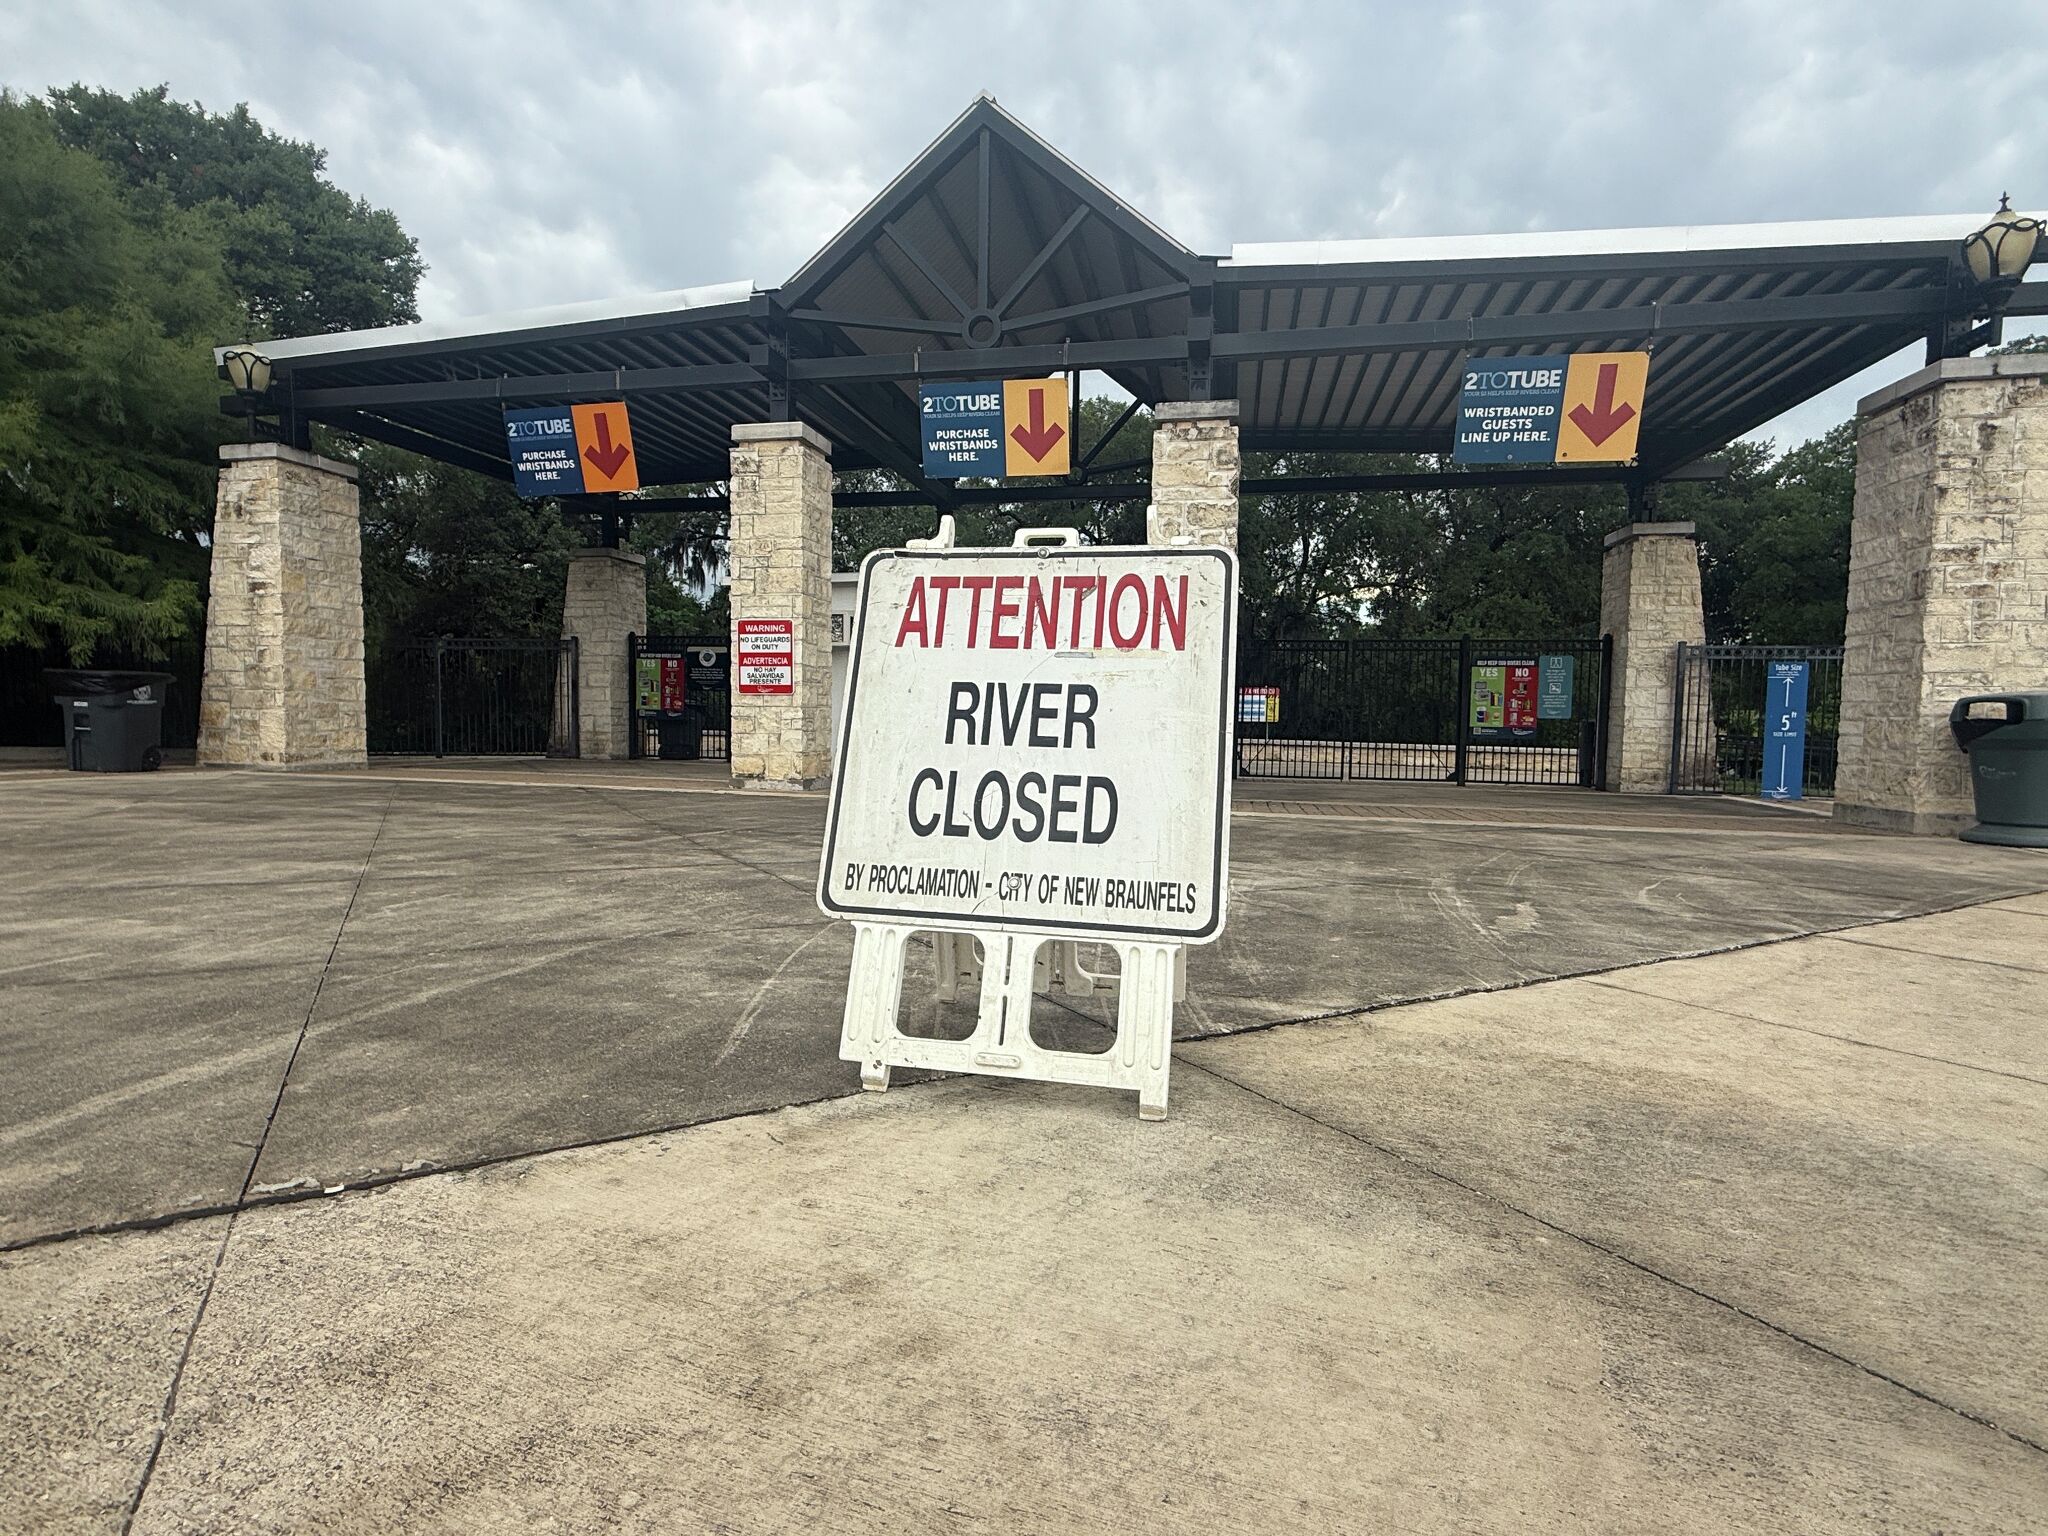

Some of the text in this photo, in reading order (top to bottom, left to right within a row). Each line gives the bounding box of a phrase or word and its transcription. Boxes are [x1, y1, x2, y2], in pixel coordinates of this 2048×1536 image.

[1464, 369, 1562, 390] 2TOTUBE
[923, 394, 1000, 413] 2TOTUBE
[1464, 406, 1554, 417] WRISTBANDED
[508, 419, 572, 437] 2TOTUBE
[1482, 419, 1532, 430] GUESTS
[936, 429, 989, 439] PURCHASE
[1461, 431, 1550, 443] LINE UP HERE.
[929, 440, 998, 451] WRISTBANDS
[522, 450, 566, 460] PURCHASE
[949, 452, 979, 462] HERE.
[517, 460, 575, 471] WRISTBANDS
[535, 472, 560, 480] HERE.
[895, 573, 1188, 652] ATTENTION
[1480, 668, 1529, 676] YES NO
[945, 681, 1099, 749] RIVER
[1781, 715, 1790, 730] 5
[908, 767, 1119, 844] CLOSED
[845, 863, 865, 890] BY
[868, 864, 980, 898] PROCLAMATION
[999, 872, 1033, 902] CITY
[1038, 874, 1059, 904] OF
[1064, 876, 1100, 906] NEW
[1105, 879, 1196, 914] BRAUNFELS
